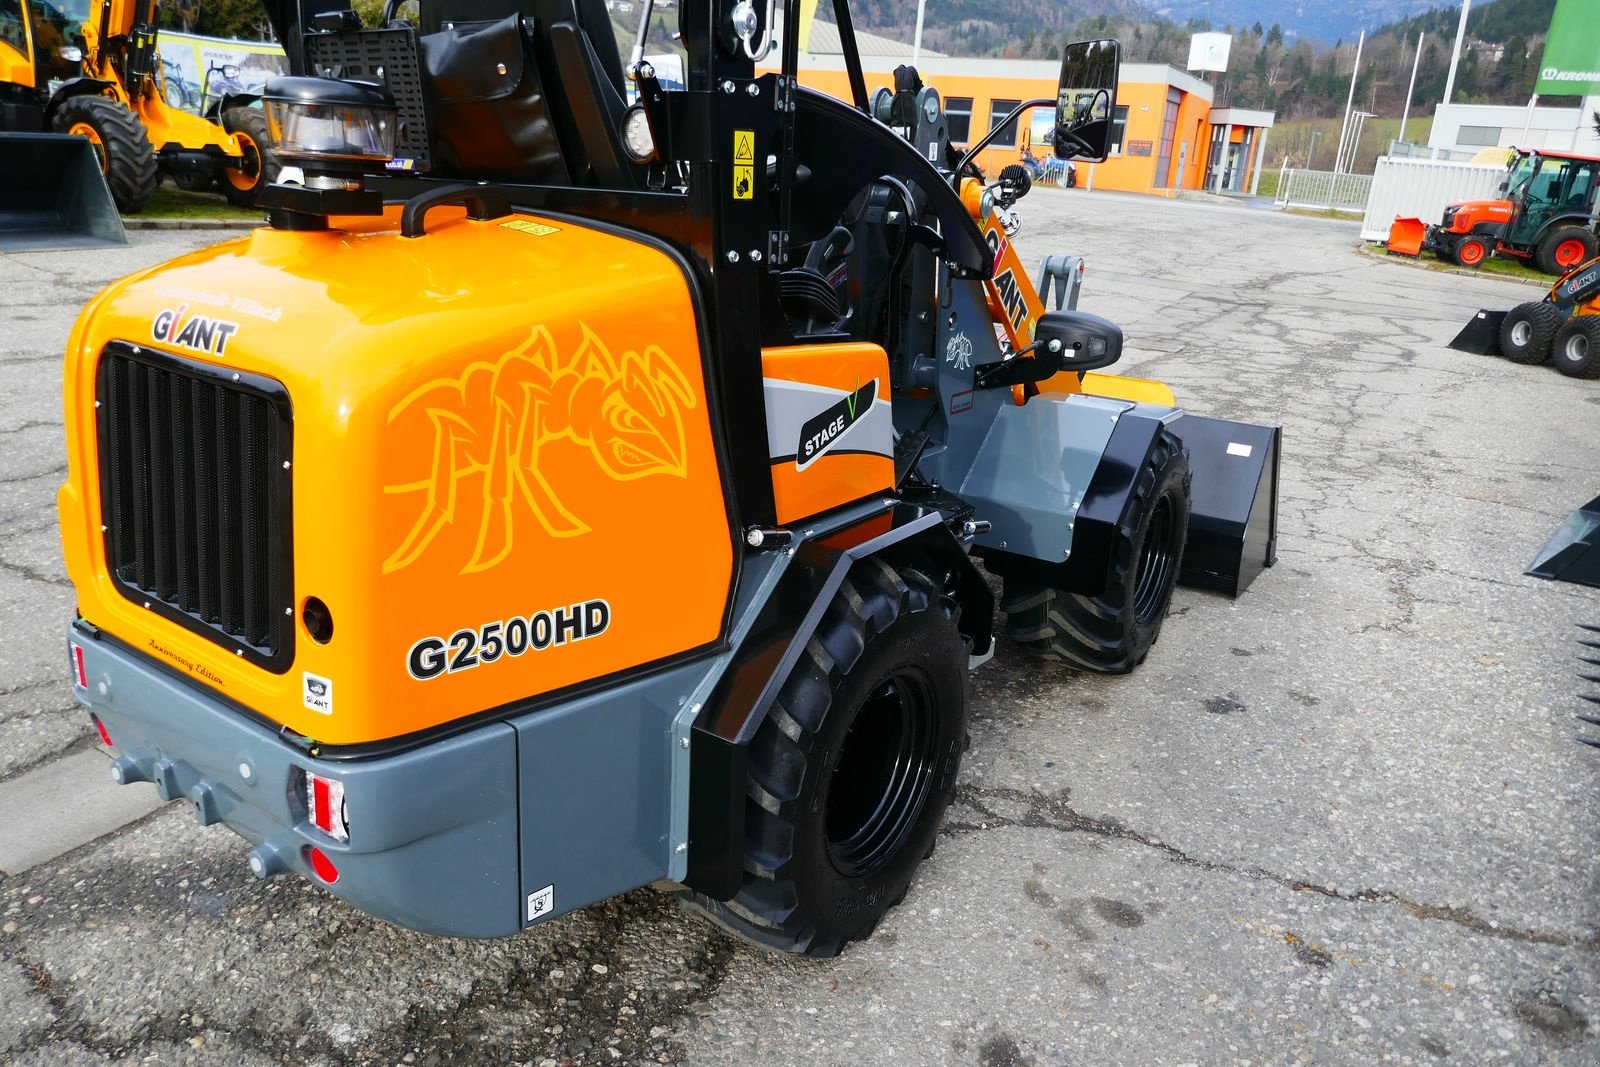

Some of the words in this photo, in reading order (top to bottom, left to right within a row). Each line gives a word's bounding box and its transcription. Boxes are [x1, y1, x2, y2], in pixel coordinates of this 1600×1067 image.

[804, 414, 846, 456] STAGE
[847, 376, 860, 420] V
[148, 639, 194, 671] Anniversary
[195, 664, 225, 687] Edition
[406, 599, 611, 680] G2500HD
